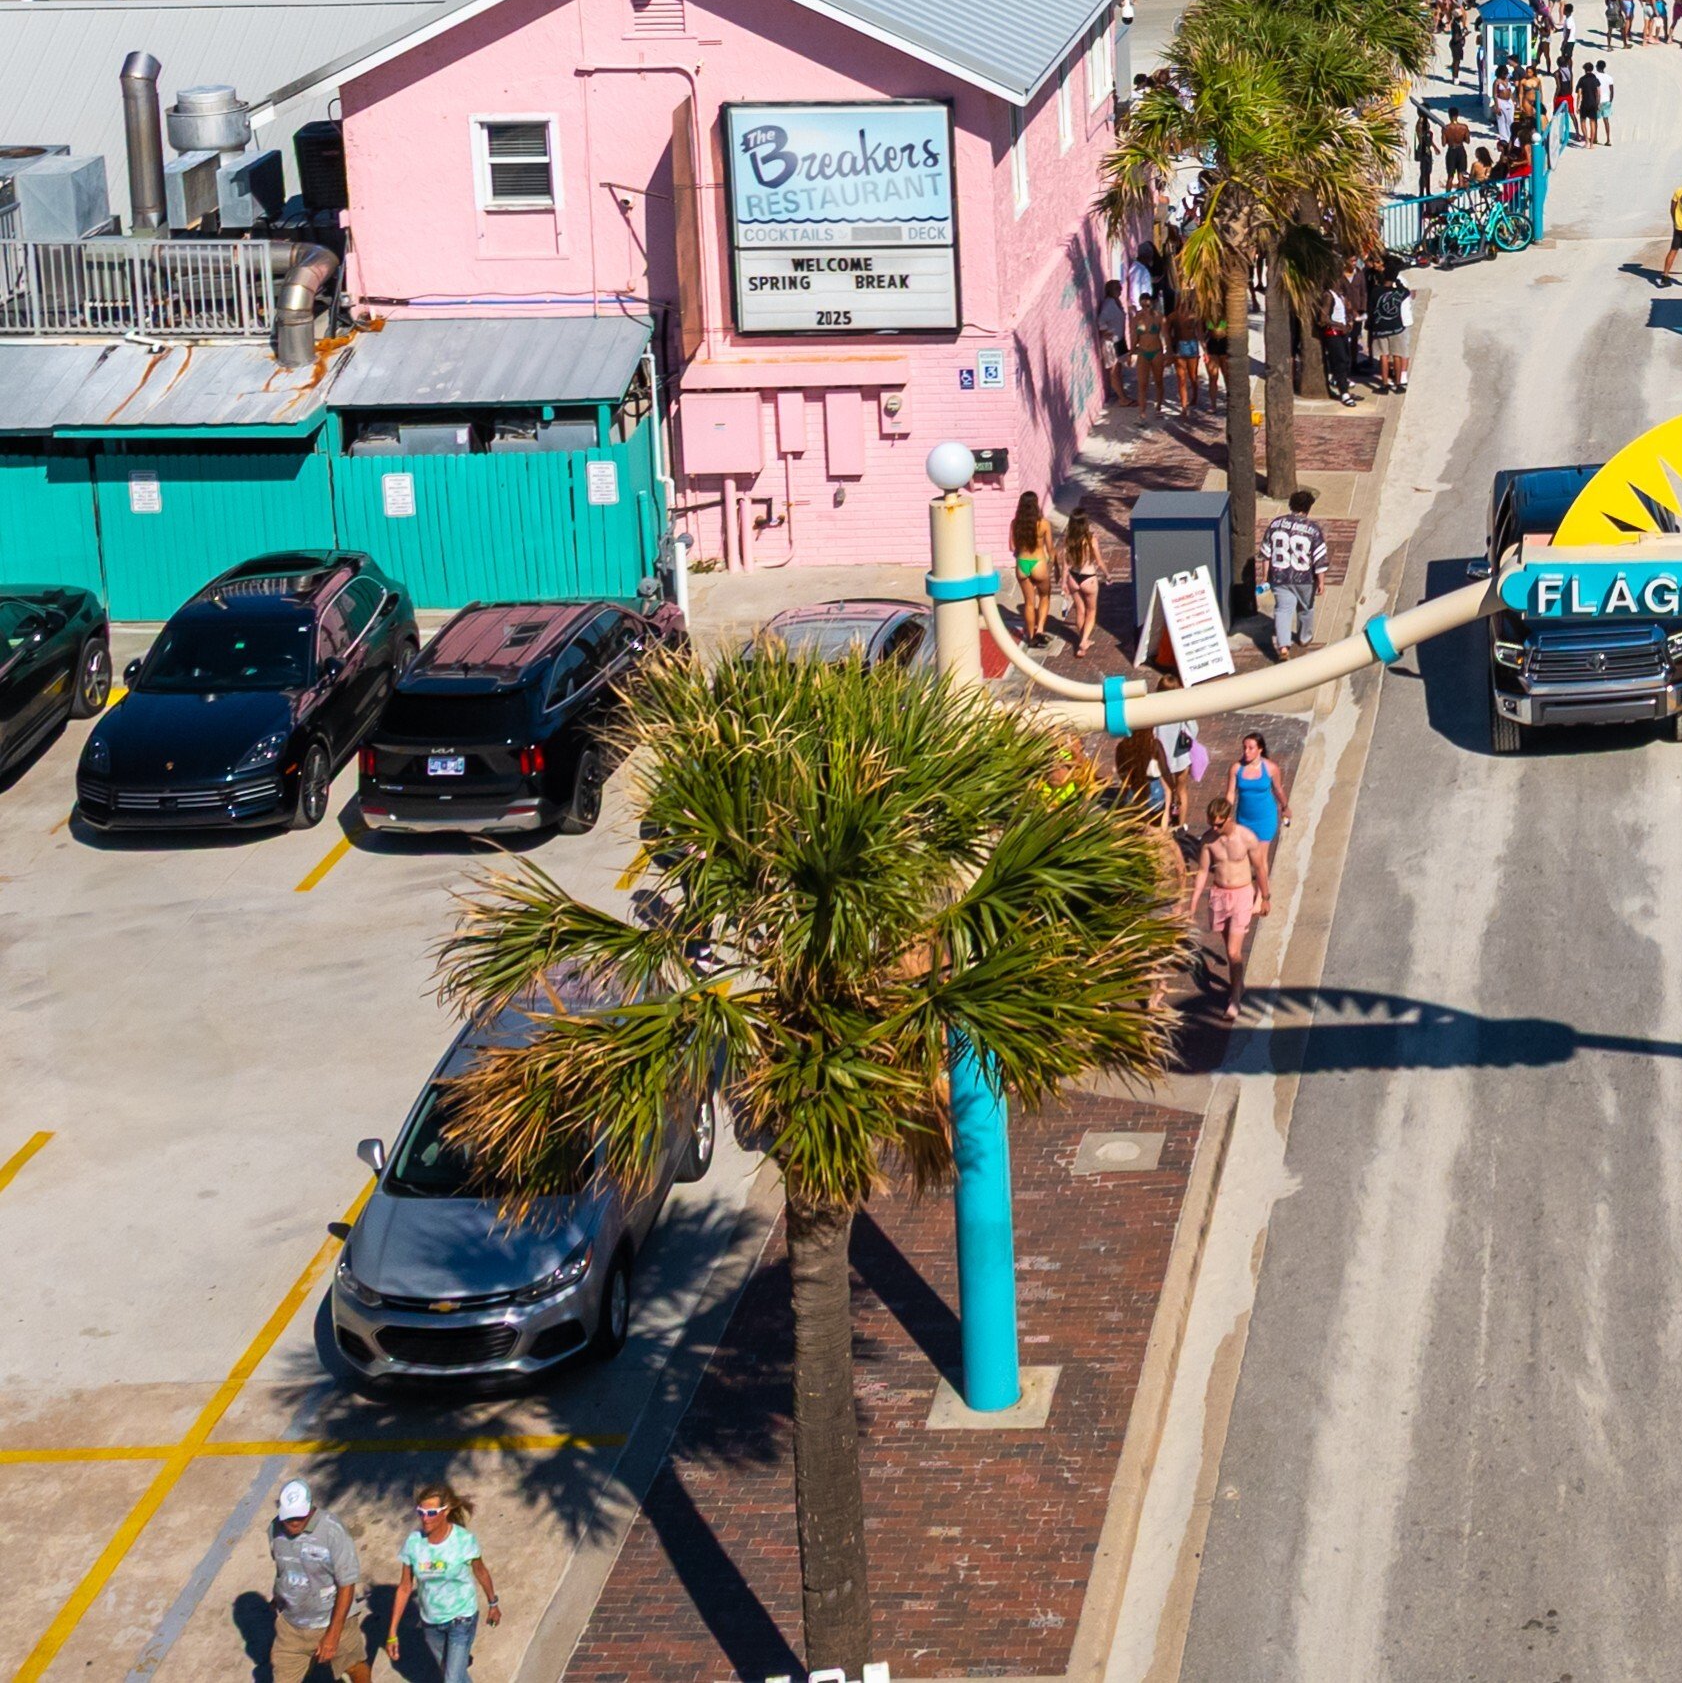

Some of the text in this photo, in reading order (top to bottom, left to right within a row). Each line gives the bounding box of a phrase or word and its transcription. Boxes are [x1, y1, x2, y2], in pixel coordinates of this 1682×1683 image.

[747, 129, 776, 149] The
[748, 124, 940, 189] Breakers
[745, 172, 943, 218] RESTAURANT
[744, 226, 946, 242] COCKTAILS DECK
[792, 258, 873, 272] WELCOME
[749, 275, 910, 291] SPRING BREAK
[816, 311, 852, 325] 2025
[1271, 530, 1312, 571] 88
